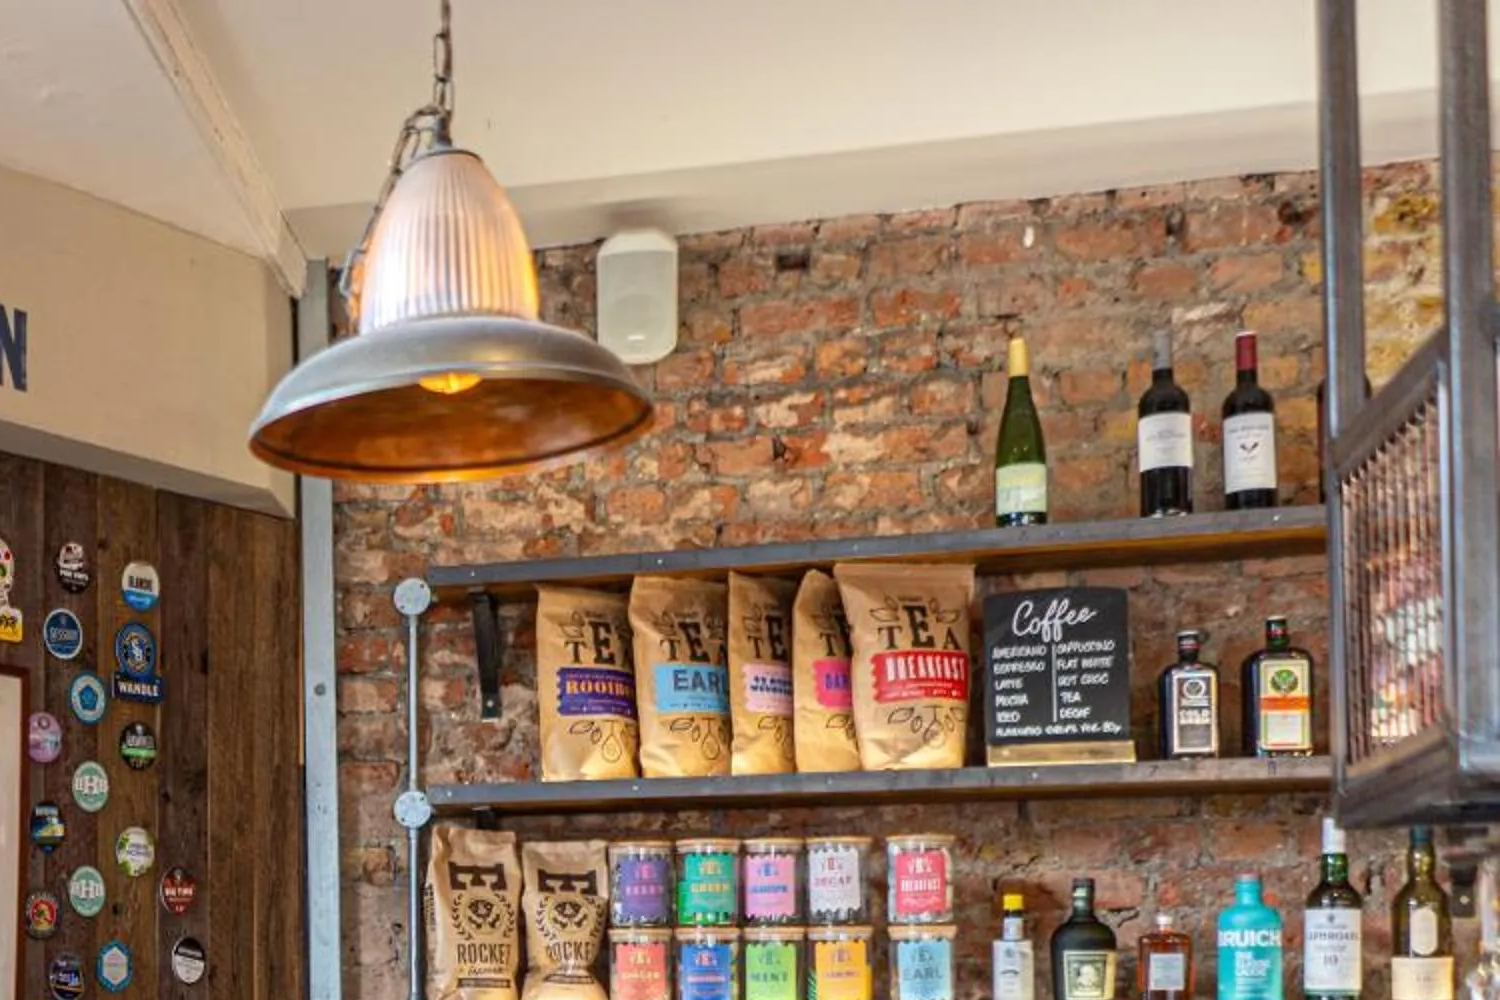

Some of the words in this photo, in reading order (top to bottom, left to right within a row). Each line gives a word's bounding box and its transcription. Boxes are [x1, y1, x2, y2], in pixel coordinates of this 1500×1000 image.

[877, 605, 963, 650] TEA
[1012, 598, 1099, 643] Coffee
[747, 615, 788, 660] TE
[885, 655, 966, 682] BREAKFAST
[993, 661, 1046, 675] ESPRESSO
[1060, 691, 1082, 703] TEA
[903, 967, 944, 982] EARL
